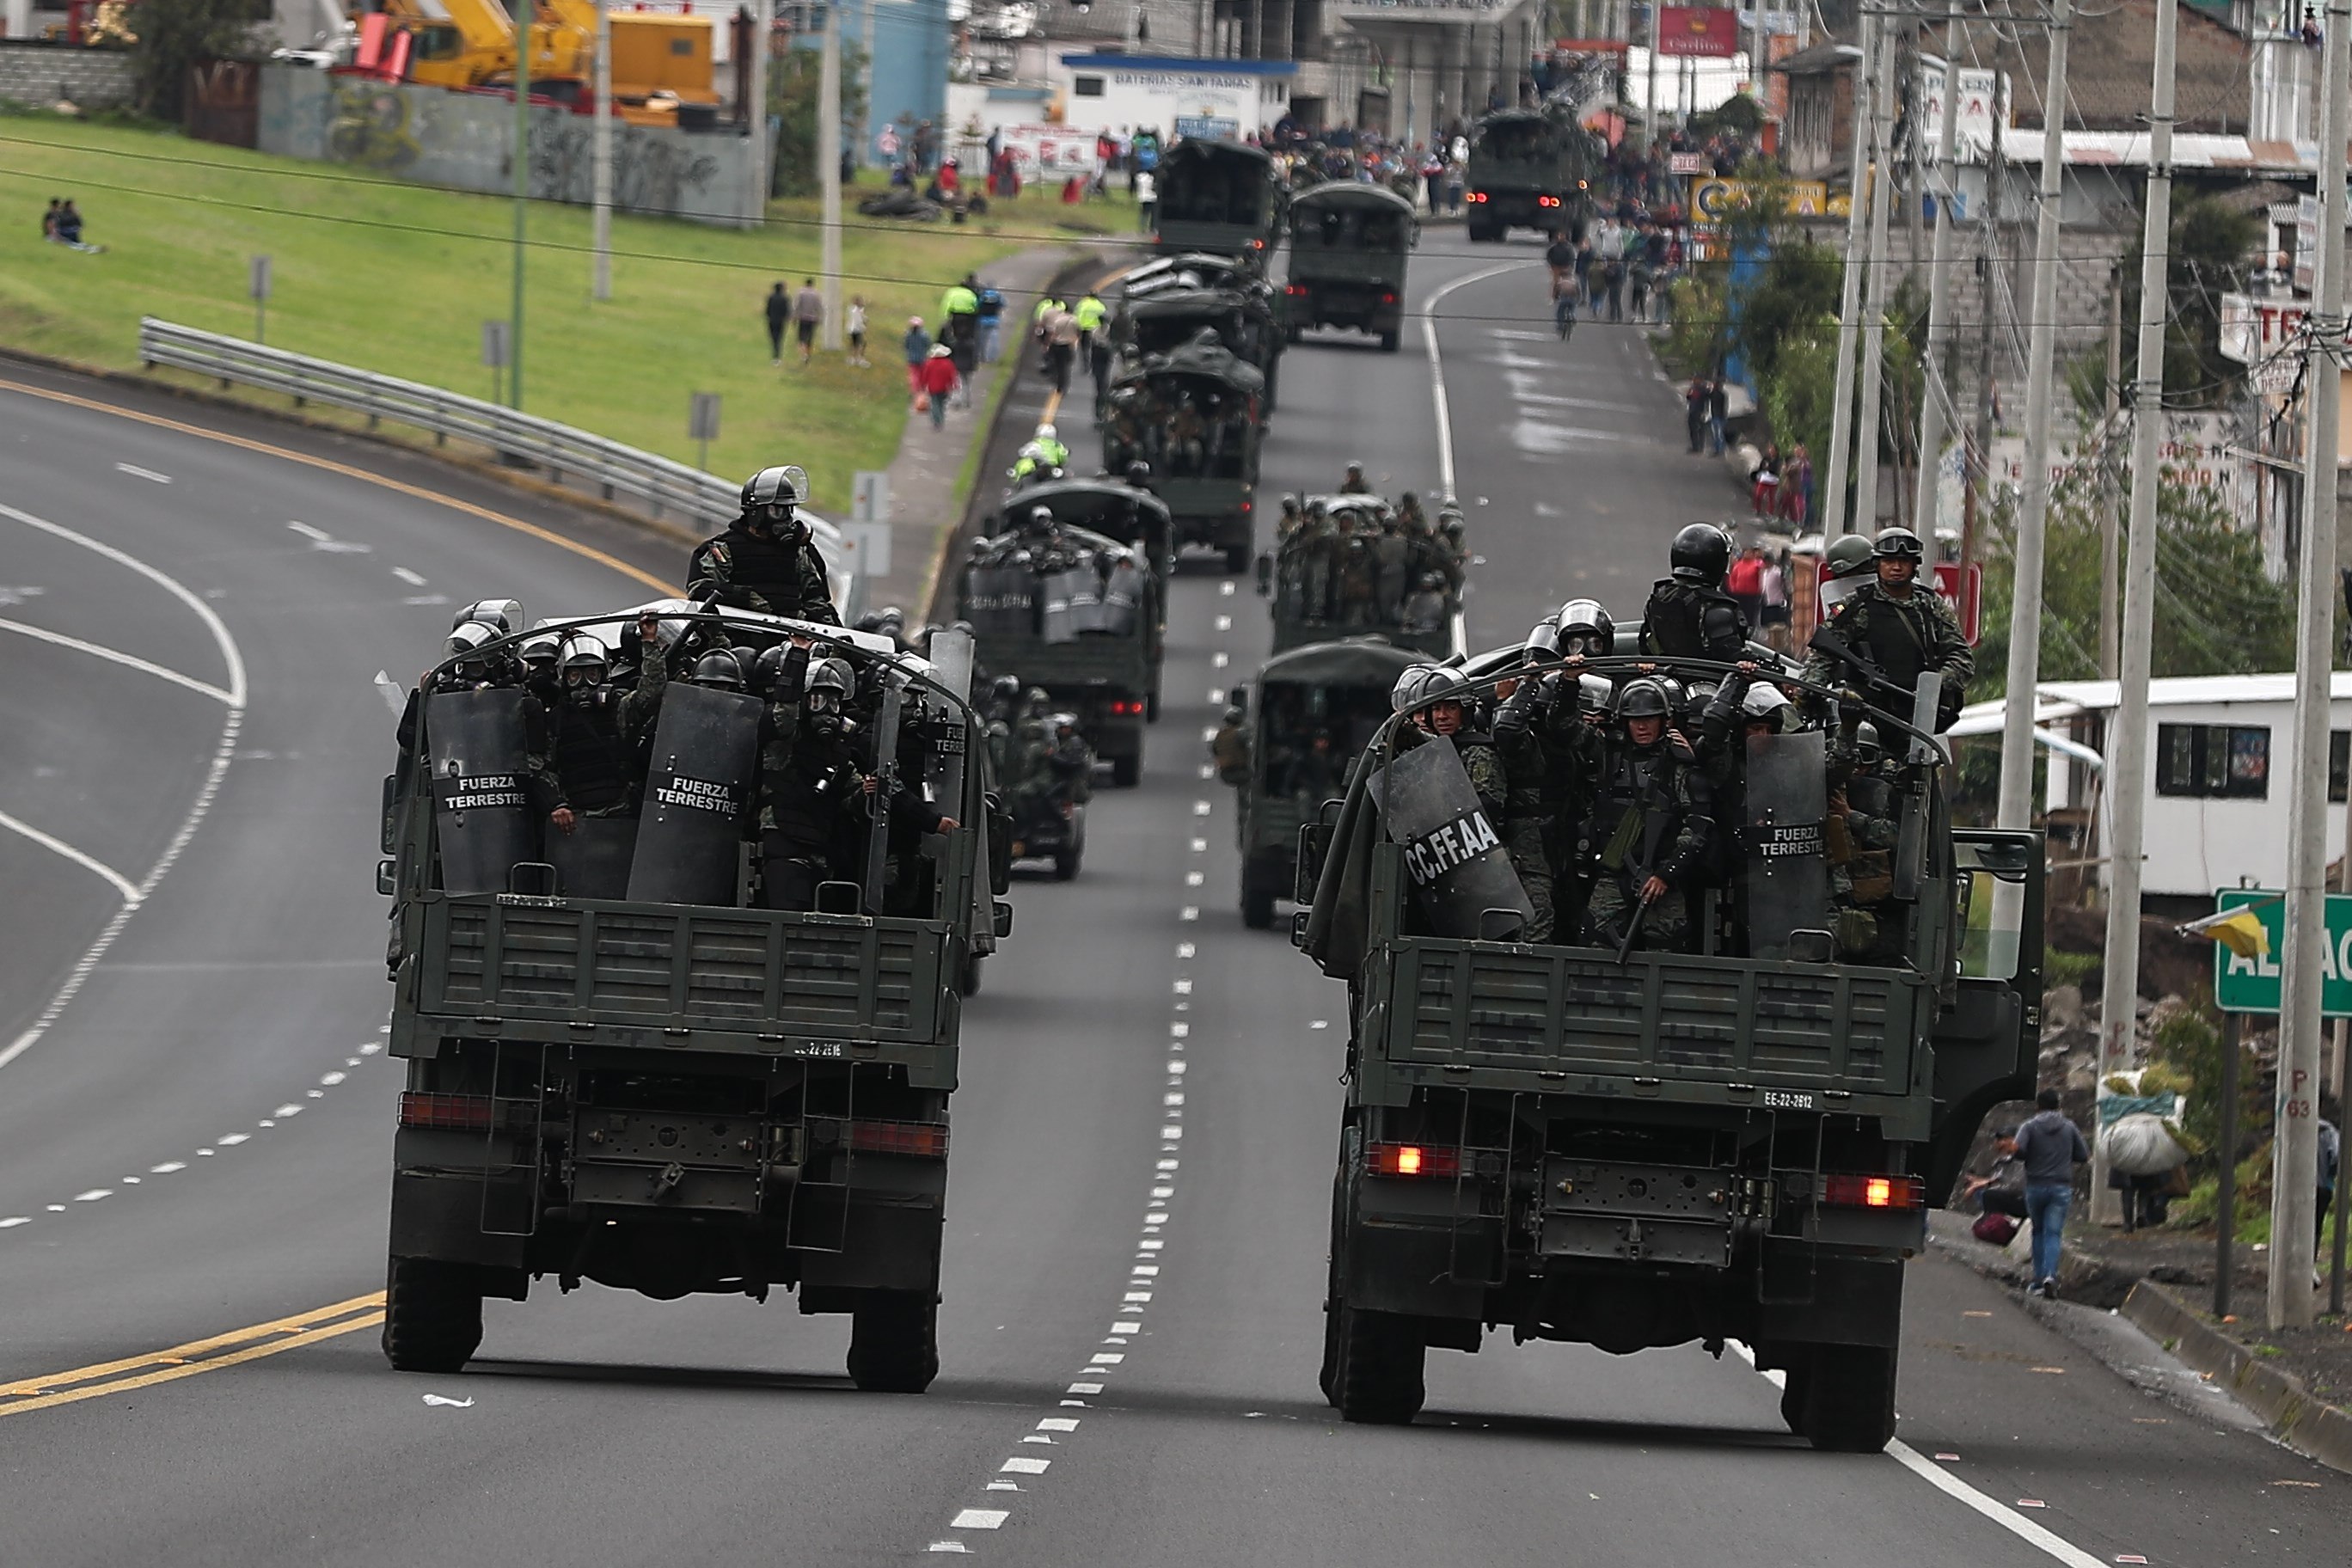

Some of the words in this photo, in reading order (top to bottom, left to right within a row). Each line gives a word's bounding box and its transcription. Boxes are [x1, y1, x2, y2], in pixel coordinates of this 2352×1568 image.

[459, 776, 516, 791] FUERZA
[672, 777, 729, 799] FUERZA
[445, 793, 526, 809] TERRESTRE
[657, 787, 738, 814] TERRESTRE
[1774, 827, 1819, 842] FUERZA
[1405, 811, 1500, 885] CC.FF.AA
[2292, 1069, 2308, 1093] P
[2287, 1099, 2310, 1118] 63
